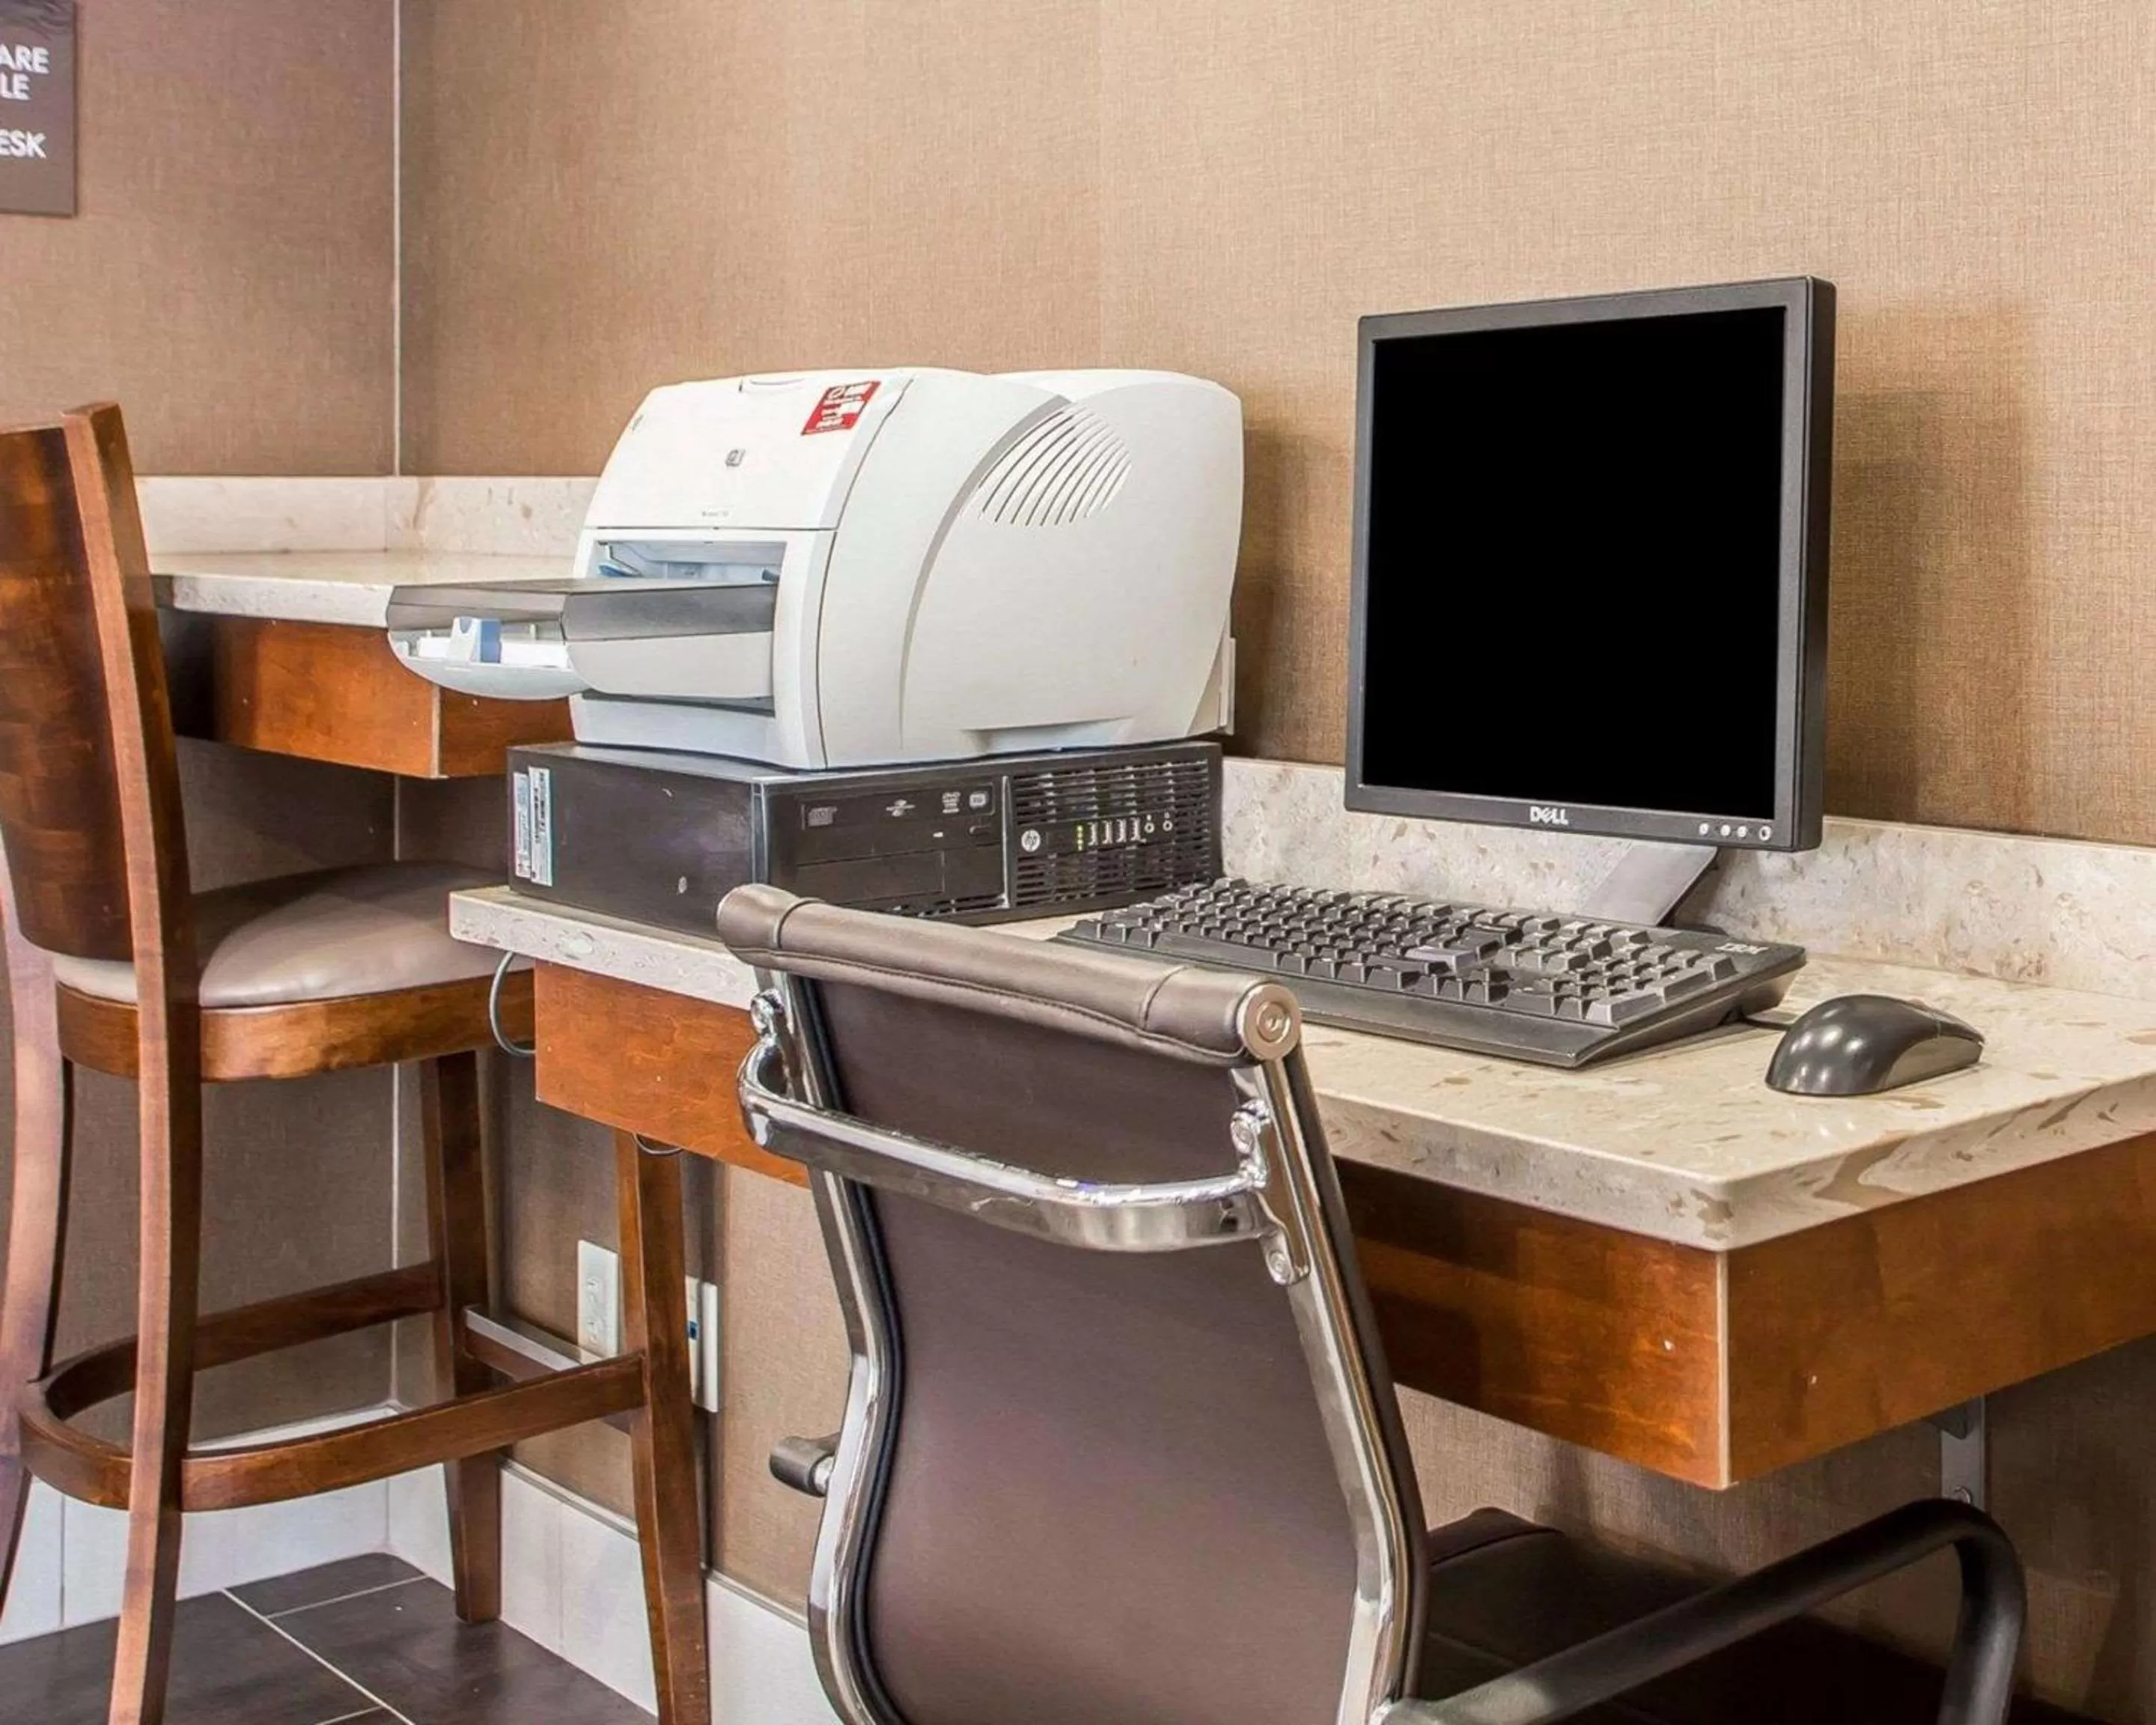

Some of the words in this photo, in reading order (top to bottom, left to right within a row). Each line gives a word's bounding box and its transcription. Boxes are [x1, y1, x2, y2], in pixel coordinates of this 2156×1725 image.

[0, 43, 50, 74] ARE
[0, 72, 31, 100] LE
[1529, 806, 1569, 825] DELL
